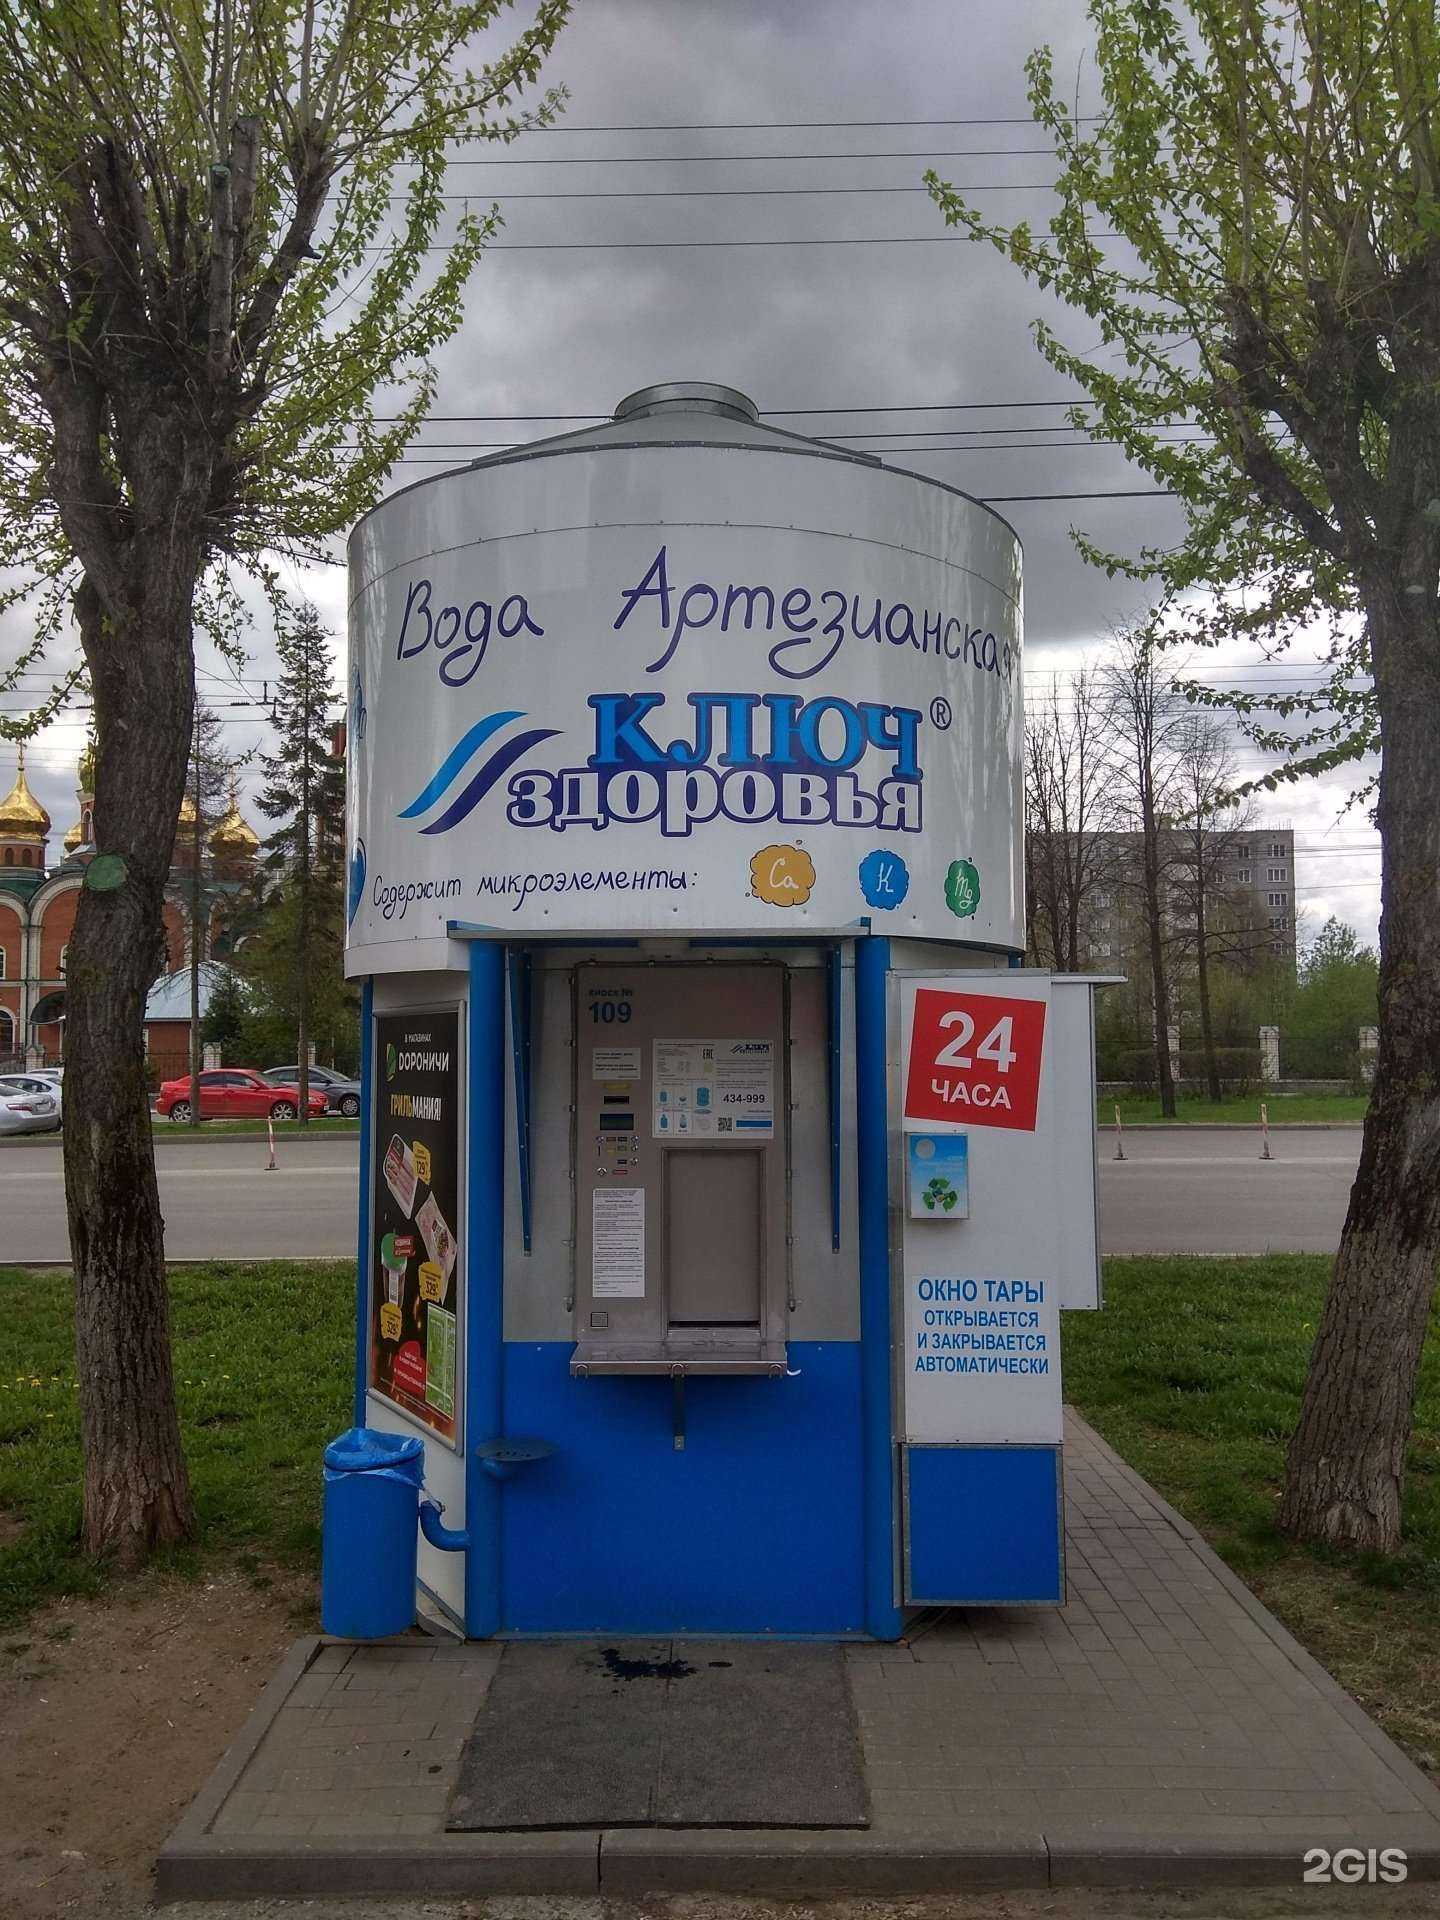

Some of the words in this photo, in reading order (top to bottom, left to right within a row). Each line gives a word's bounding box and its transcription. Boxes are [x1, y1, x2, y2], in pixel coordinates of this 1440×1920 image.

[397, 578, 545, 688] Вода
[612, 545, 1012, 684] Артезианская
[587, 692, 923, 780] КЛЮЧ
[769, 857, 799, 889] Ca
[373, 875, 461, 920] Содержит
[477, 869, 699, 912] микроэлементы:
[589, 1001, 632, 1024] 109
[934, 1010, 1017, 1073] 24
[723, 1093, 766, 1104] 434-999
[931, 1078, 1013, 1110] ЧАСА
[918, 1279, 978, 1301] ОКНО
[984, 1280, 1044, 1303] ТАРЫ
[924, 1309, 1039, 1328] ОТКРЫВАЕТСЯ
[917, 1332, 928, 1349] И
[932, 1332, 1046, 1351] ЗАКРЫВАЕТСЯ
[915, 1355, 1049, 1374] АВТОМАТИЧЕСКИ
